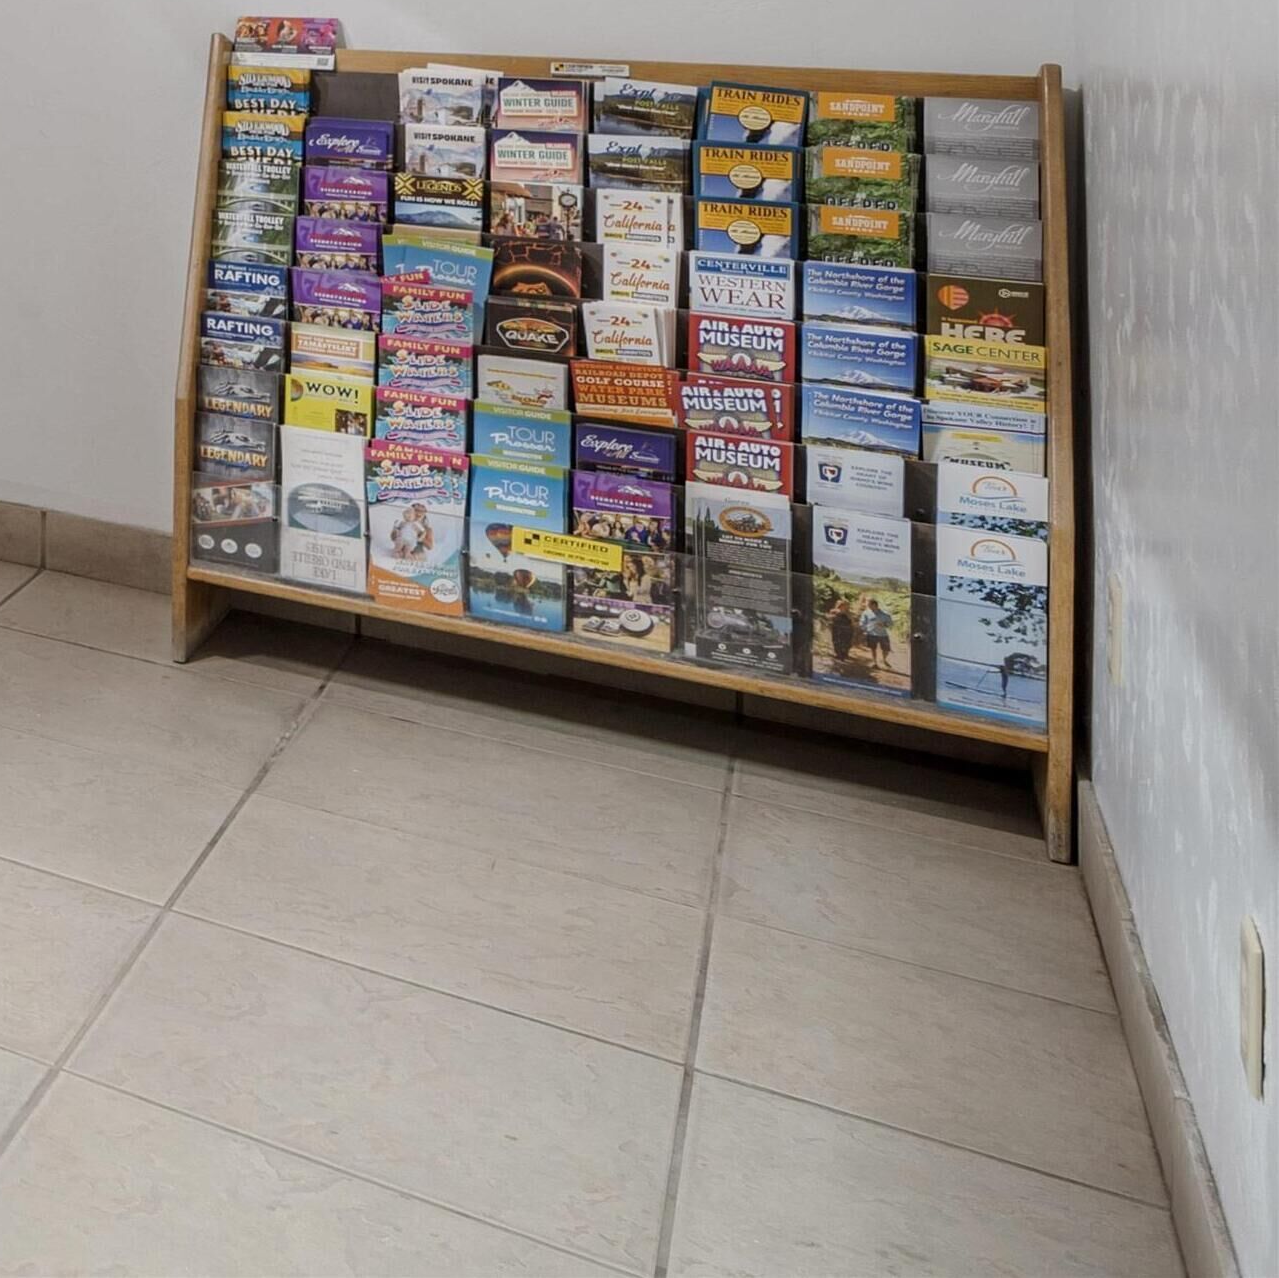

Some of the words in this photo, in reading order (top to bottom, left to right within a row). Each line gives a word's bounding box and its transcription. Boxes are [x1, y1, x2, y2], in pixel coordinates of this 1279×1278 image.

[412, 76, 430, 85] VISIT
[430, 78, 473, 87] SPOKANE
[234, 98, 267, 109] BEST
[270, 99, 297, 109] DAY
[503, 98, 541, 108] WINTER
[544, 98, 574, 108] GUIDE
[716, 88, 757, 101] TRAIN
[761, 93, 801, 106] RIDES
[829, 102, 886, 114] SANDPOINT
[938, 102, 1032, 132] Maryhill
[413, 132, 432, 141] VISIT
[432, 133, 475, 143] SPOKANE
[230, 146, 263, 156] BEST
[266, 147, 294, 157] DAY
[497, 149, 535, 159] WINTER
[538, 150, 569, 160] GUIDE
[705, 147, 745, 160] TRAIN
[749, 150, 789, 163] RIDES
[834, 158, 891, 171] SANDPOINT
[416, 179, 462, 192] LEGENDS
[937, 163, 1031, 193] Maryhill
[622, 200, 643, 211] 24
[703, 202, 743, 215] TRAIN
[748, 206, 788, 219] RIDES
[603, 213, 663, 233] California
[831, 216, 889, 230] SANDPOINT
[939, 220, 1034, 251] Maryhill
[452, 246, 476, 256] GUIDE
[433, 259, 477, 278] TOUR
[630, 258, 651, 270] 24
[697, 259, 787, 274] CENTERVILLE
[214, 269, 281, 286] RAFTING
[400, 273, 424, 282] FUN
[610, 271, 670, 291] California
[698, 274, 786, 293] WESTERN
[807, 268, 822, 276] The
[824, 270, 876, 282] Northshore
[890, 276, 905, 284] the
[392, 285, 435, 297] FAMILY
[439, 290, 466, 300] FUN
[808, 277, 850, 286] Columbia
[850, 281, 874, 289] River
[876, 284, 905, 293] Gorge
[700, 286, 786, 310] WEAR
[206, 318, 274, 336] RAFTING
[610, 315, 630, 326] 24
[698, 319, 729, 332] AIR
[742, 324, 785, 338] AUTO
[505, 330, 559, 344] QUAKE
[591, 329, 653, 347] California
[699, 331, 784, 352] MUSEUM
[807, 332, 822, 341] The
[825, 334, 876, 347] Northshore
[891, 341, 906, 349] the
[386, 339, 430, 352] FAMILY
[434, 345, 461, 355] FUN
[808, 341, 850, 351] Columbia
[851, 346, 875, 354] River
[876, 348, 906, 358] Gorge
[932, 342, 974, 355] SAGE
[976, 346, 1041, 362] CENTER
[575, 369, 628, 379] RAILROAD
[629, 371, 664, 380] DEPOT
[576, 376, 611, 385] GOLF
[614, 378, 665, 388] COURSE
[305, 382, 359, 404] WOW!
[383, 390, 426, 403] FAMILY
[430, 397, 457, 407] FUN
[577, 385, 625, 396] WATER
[628, 387, 665, 397] PARK
[681, 386, 710, 397] AIR
[722, 386, 765, 398] AUTO
[204, 397, 273, 418] LEGENDARY
[578, 393, 668, 407] MUSEUMS
[682, 397, 767, 413] MUSEUM
[813, 391, 830, 399] The
[832, 394, 884, 407] Northshore
[898, 405, 914, 413] the
[524, 410, 552, 420] GUIDE
[814, 401, 856, 411] Columbia
[857, 406, 881, 415] River
[883, 410, 913, 421] Gorge
[507, 425, 555, 445] TOUR
[580, 434, 633, 452] Explore
[694, 435, 726, 450] AIR
[737, 442, 781, 457] AUTO
[200, 445, 268, 468] LEGENDARY
[370, 448, 414, 461] FAMILY
[417, 454, 444, 464] FUN
[695, 448, 781, 471] MUSEUM
[518, 464, 546, 475] GUIDE
[501, 479, 550, 499] TOUR
[960, 496, 996, 509] Moses
[999, 501, 1027, 513] Lake
[544, 535, 609, 553] CERTIFIED
[957, 559, 994, 572] Moses
[996, 565, 1027, 577] Lake
